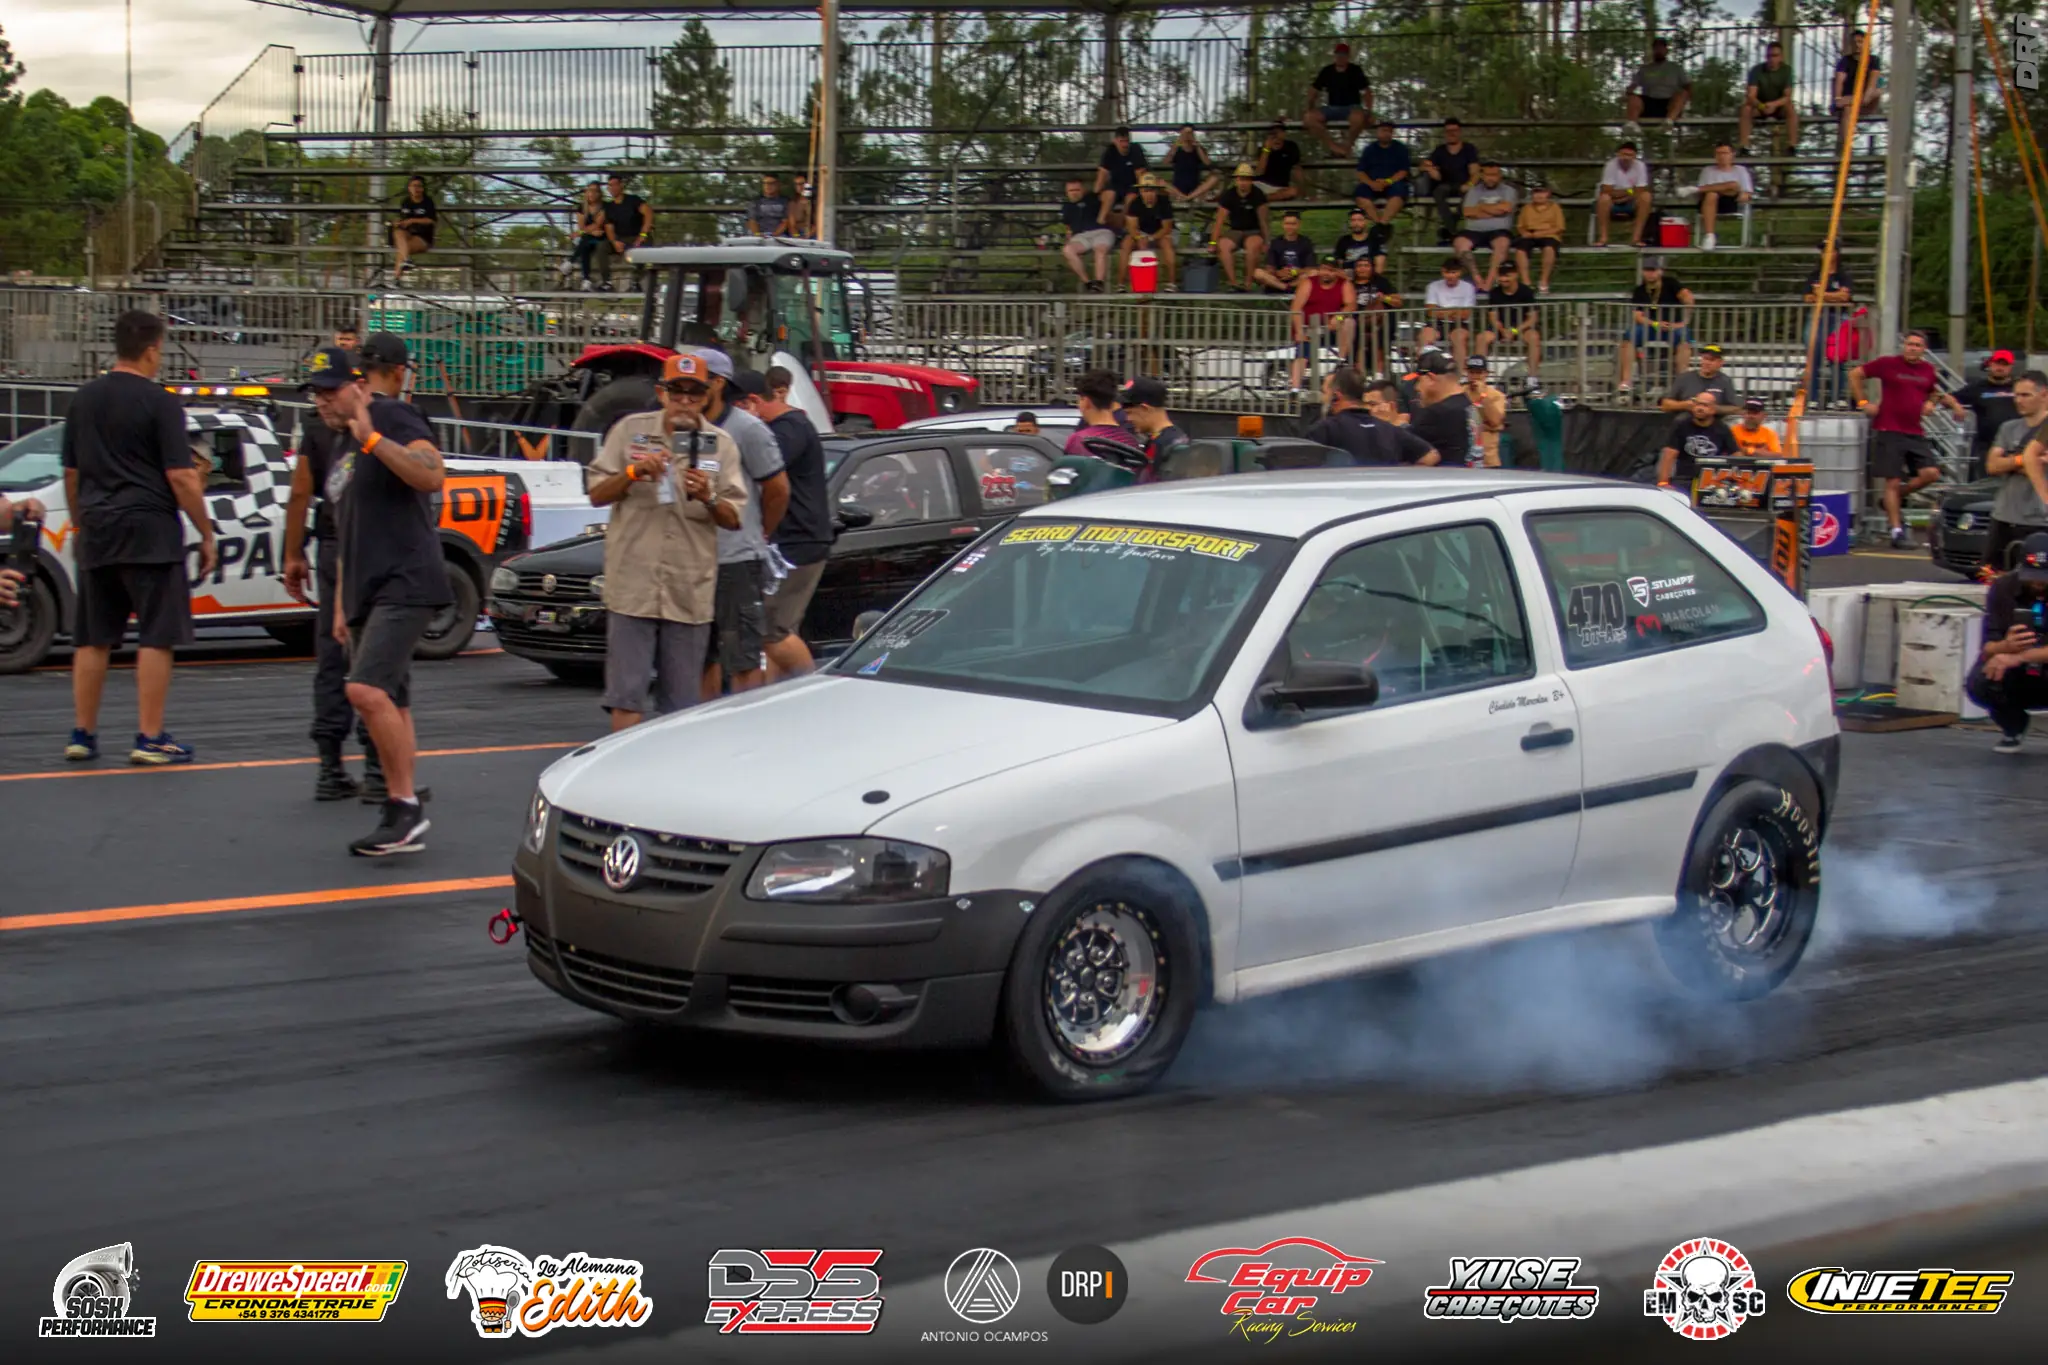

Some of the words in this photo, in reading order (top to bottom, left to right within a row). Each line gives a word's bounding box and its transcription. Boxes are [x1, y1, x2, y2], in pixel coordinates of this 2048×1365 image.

[1002, 525, 1080, 544] SERRO
[1077, 525, 1258, 560] MOTORSPORT
[1651, 575, 1695, 590] STUMPF
[1655, 588, 1697, 601] CABEÇOTES
[1567, 581, 1626, 631] 470
[1662, 604, 1720, 623] MARCOLAN
